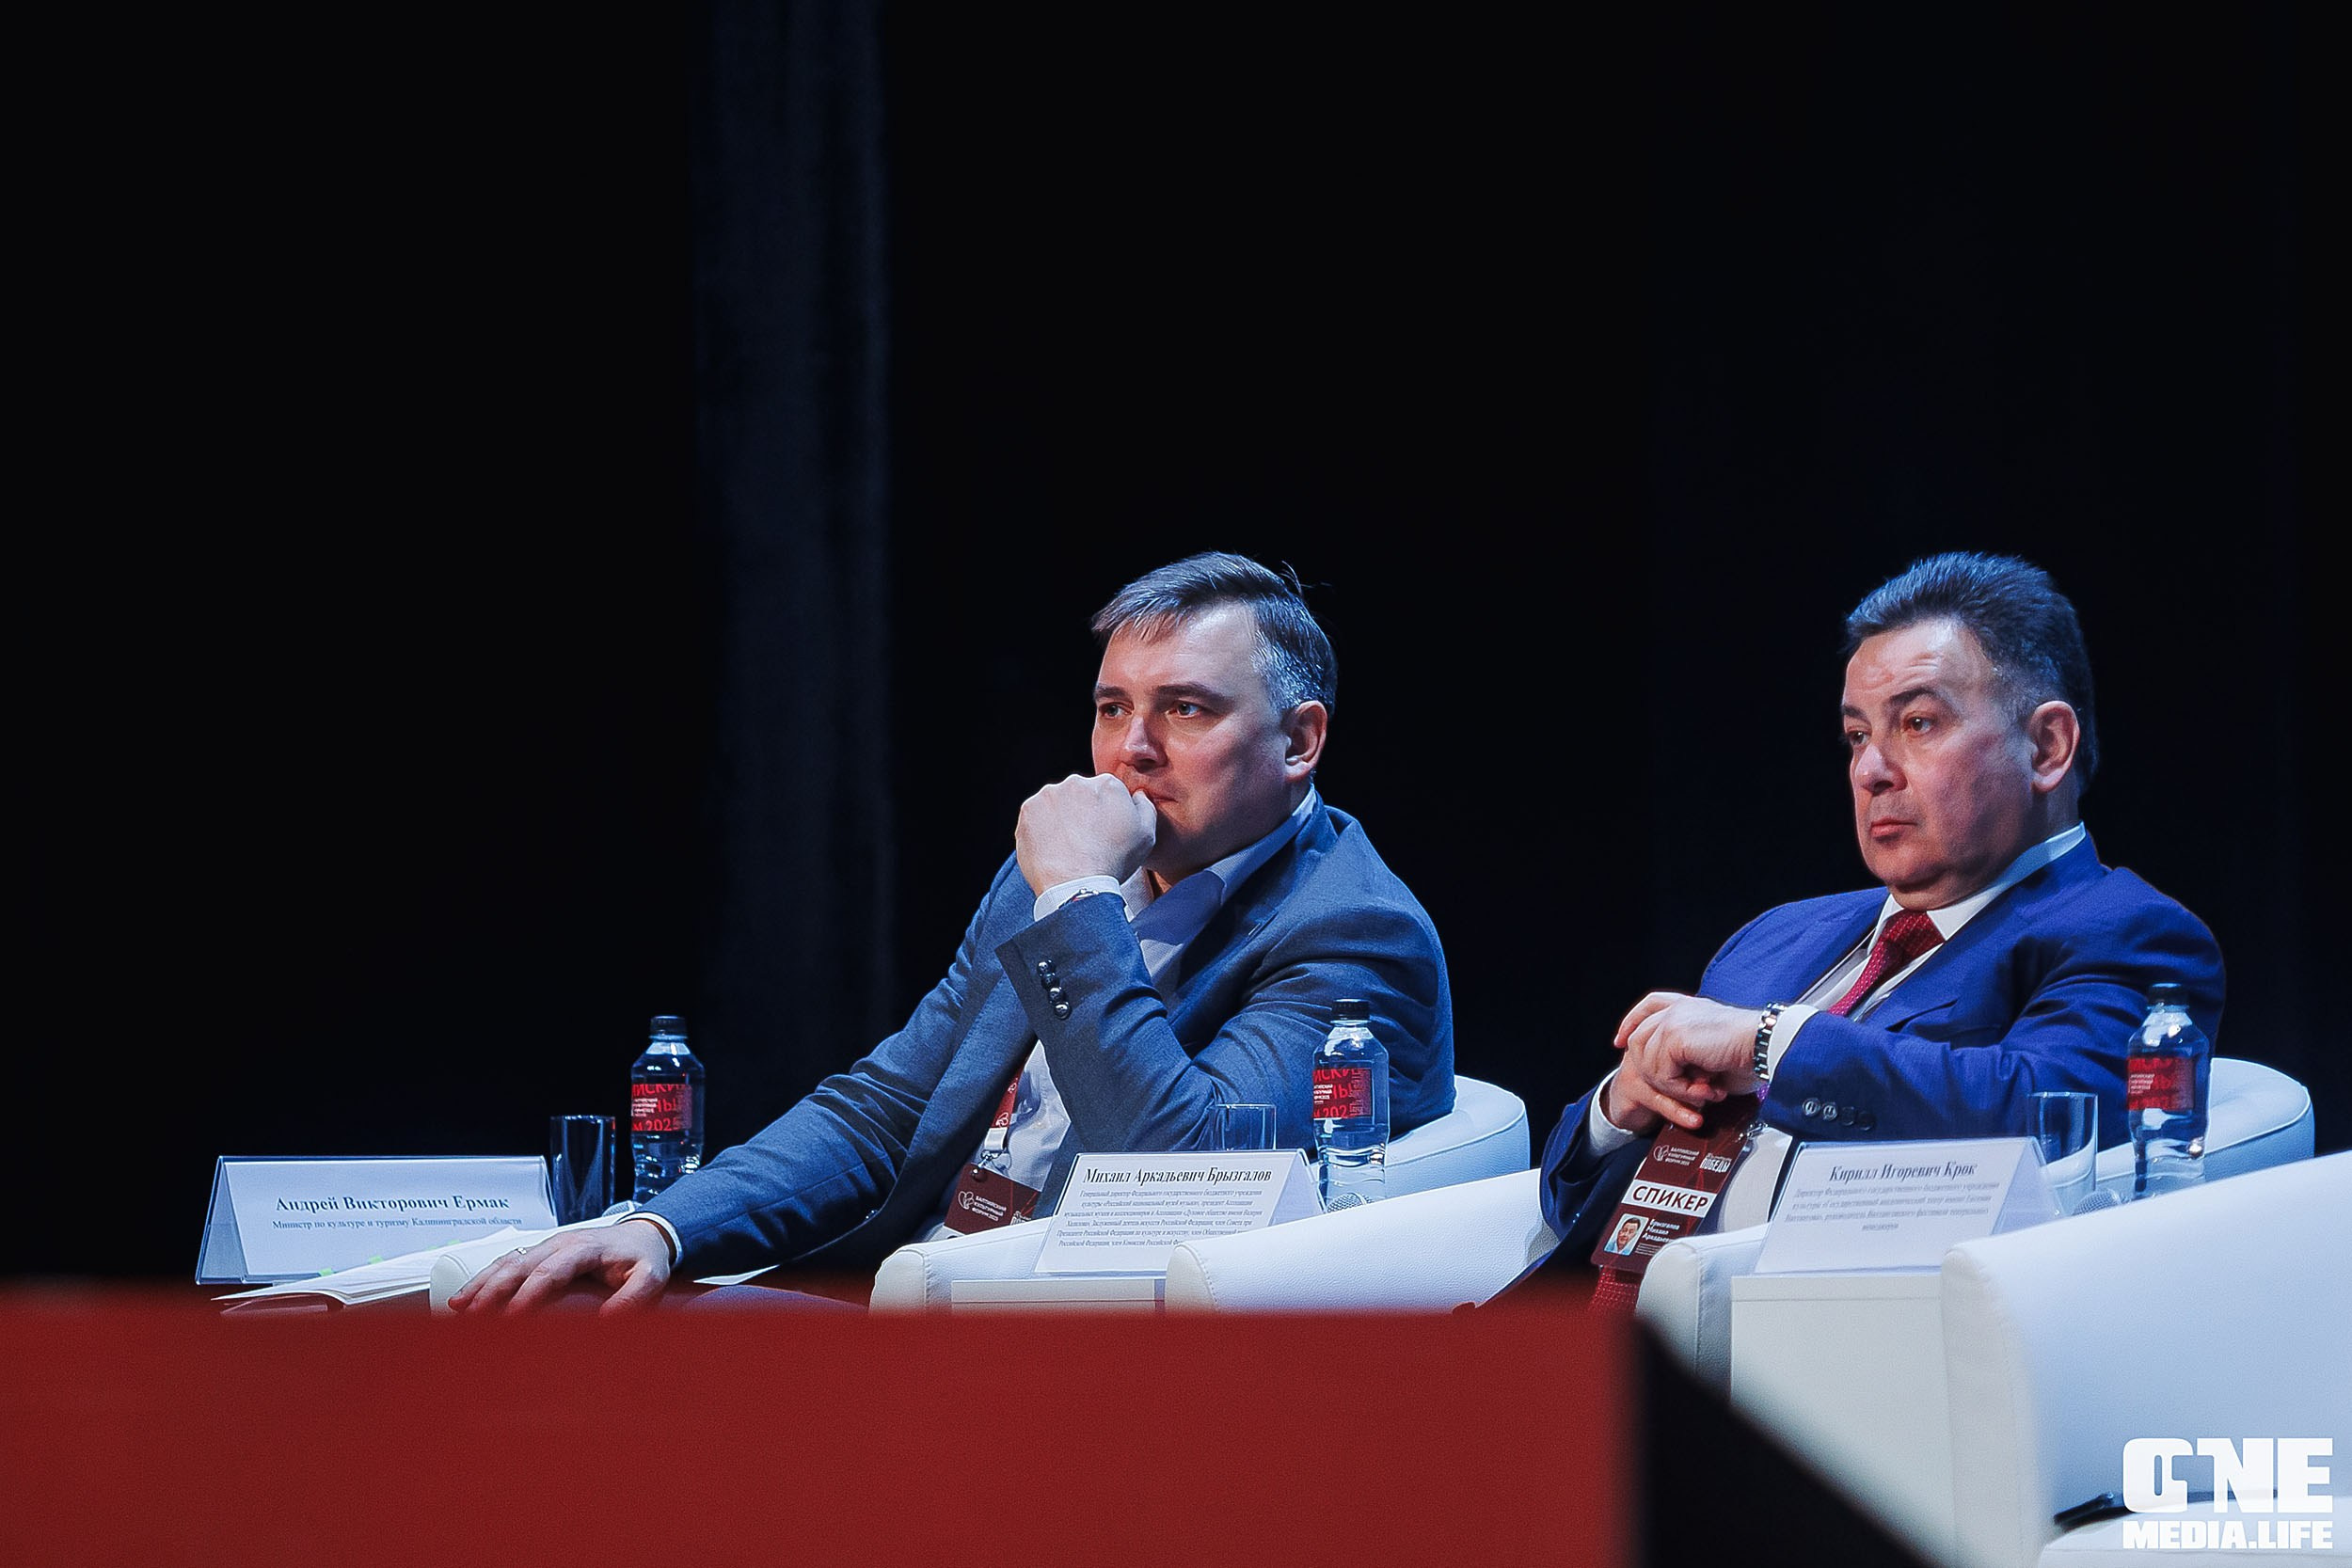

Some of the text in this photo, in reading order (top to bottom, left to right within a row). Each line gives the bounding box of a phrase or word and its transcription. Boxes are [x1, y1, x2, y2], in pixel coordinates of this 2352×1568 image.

[1083, 1166, 1272, 1186] Михаил Аркадьевич Брызгалов
[1830, 1162, 1978, 1185] Кирилл Игоревич Крок
[276, 1195, 510, 1213] Андрей Викторович Ермак
[1632, 1186, 1708, 1212] СПИКЕР
[272, 1220, 312, 1230] Министр
[326, 1220, 366, 1229] культуре
[375, 1220, 409, 1228] туризму
[411, 1217, 486, 1227] Калининградской
[488, 1216, 522, 1226] области
